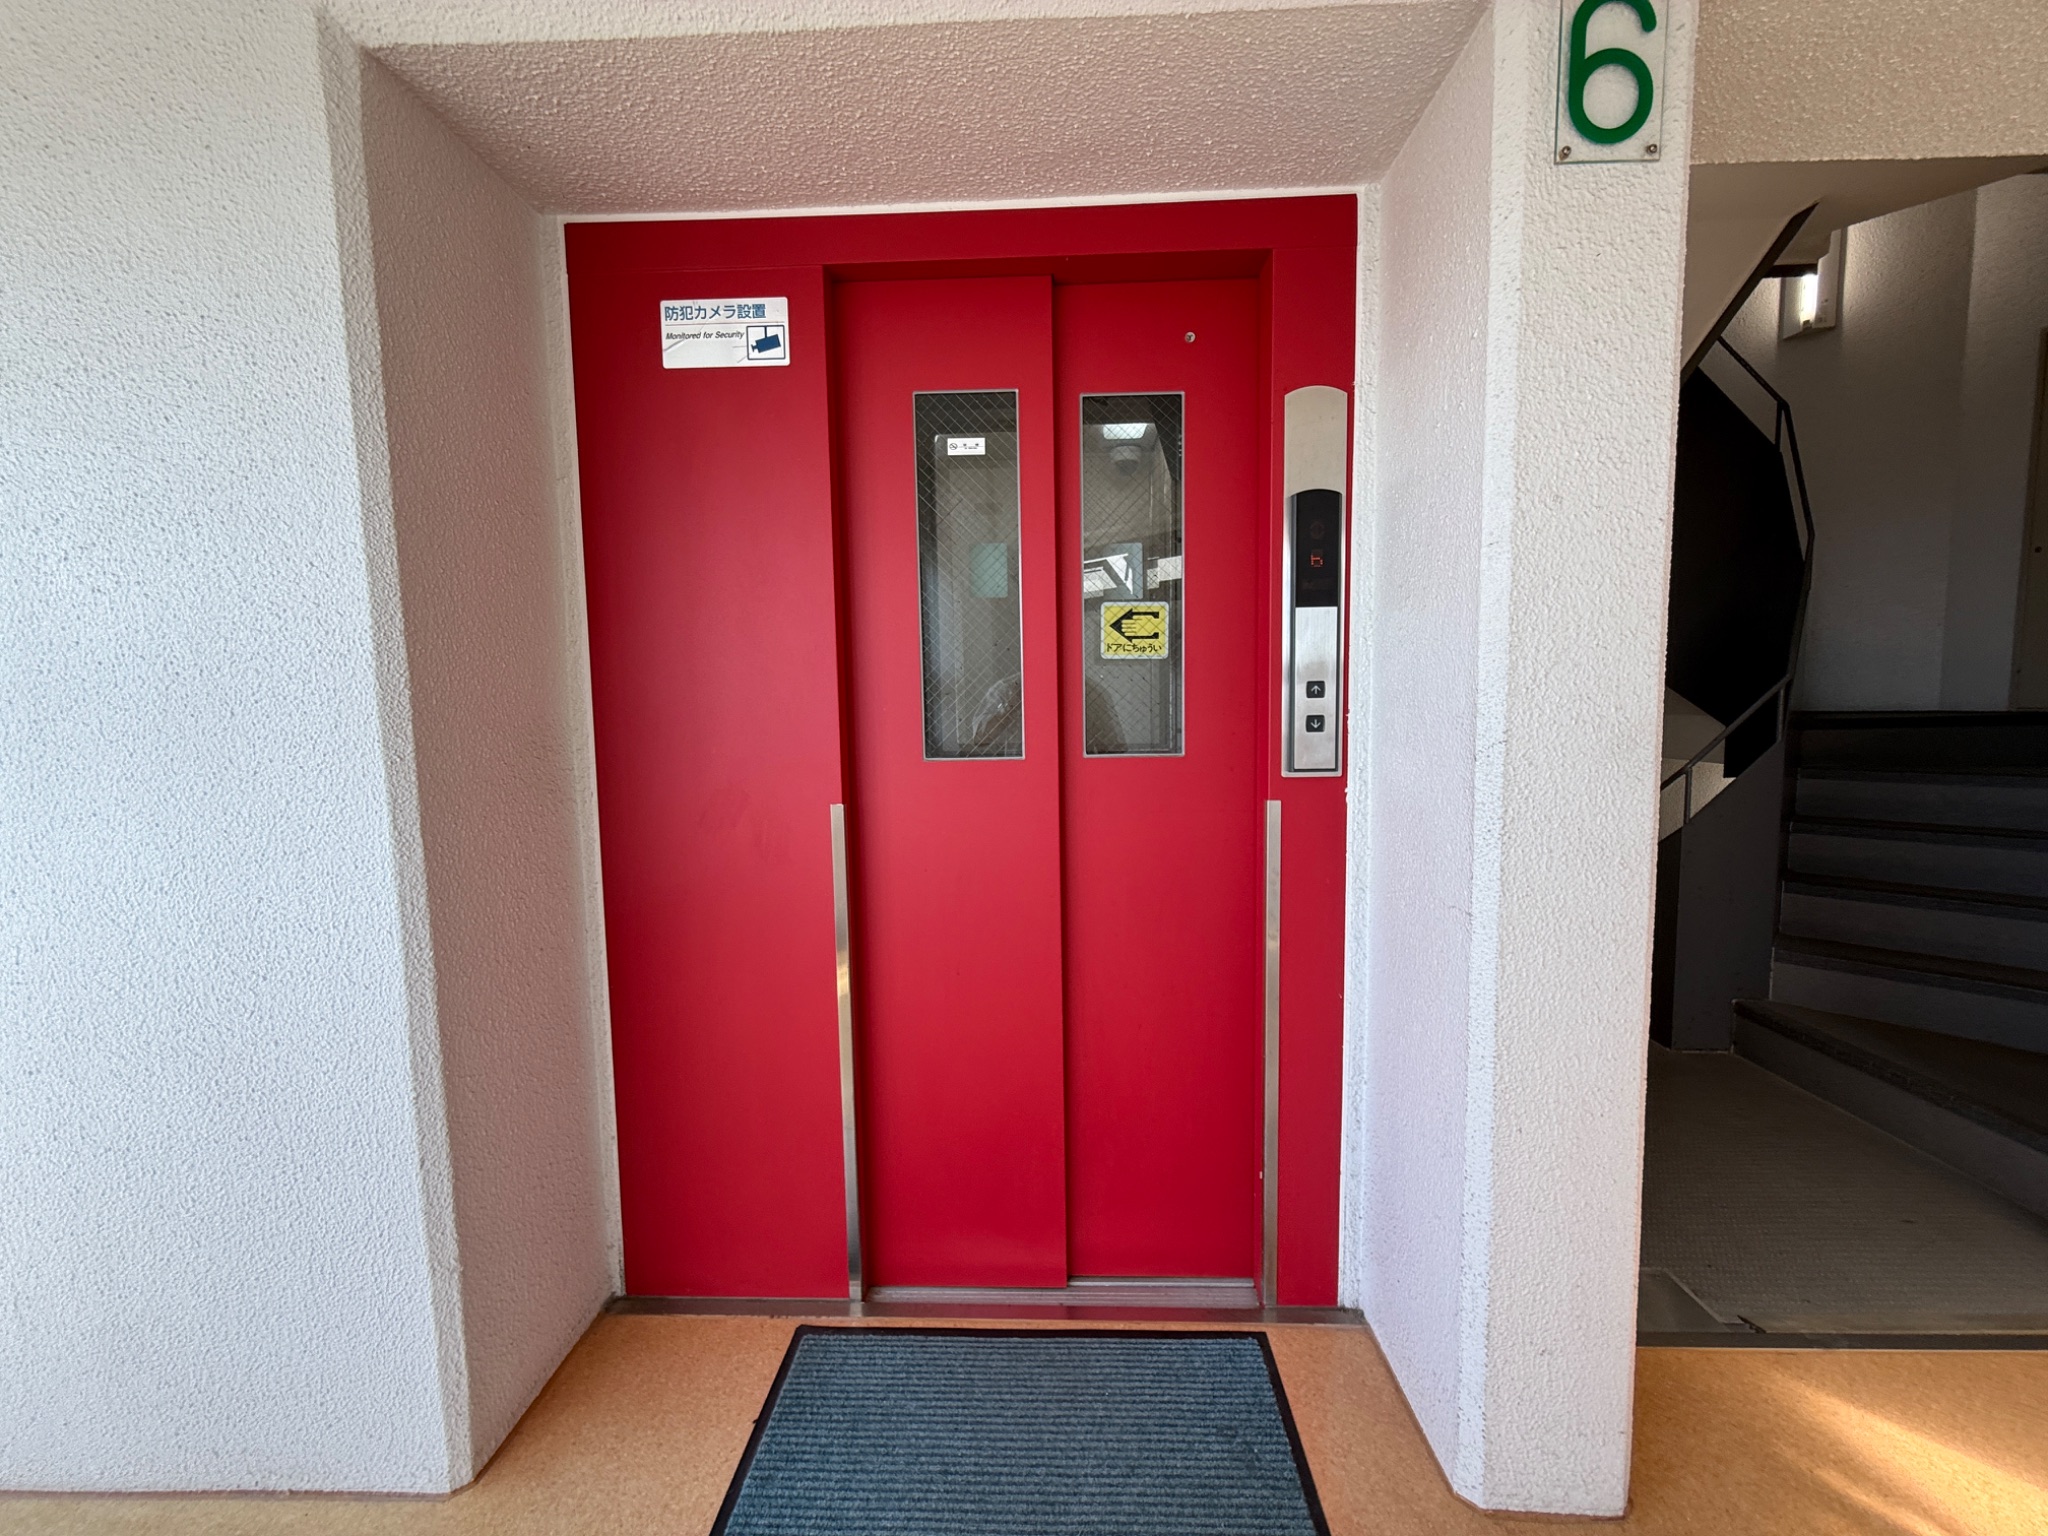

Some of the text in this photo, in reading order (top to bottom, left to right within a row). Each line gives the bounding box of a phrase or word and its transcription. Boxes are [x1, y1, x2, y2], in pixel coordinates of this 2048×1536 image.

[1568, 0, 1657, 145] 6
[664, 303, 767, 321] 防犯カメラ設置
[665, 332, 701, 340] Monitored
[715, 330, 745, 340] Security
[1106, 643, 1162, 653] ドアにちゅうい
